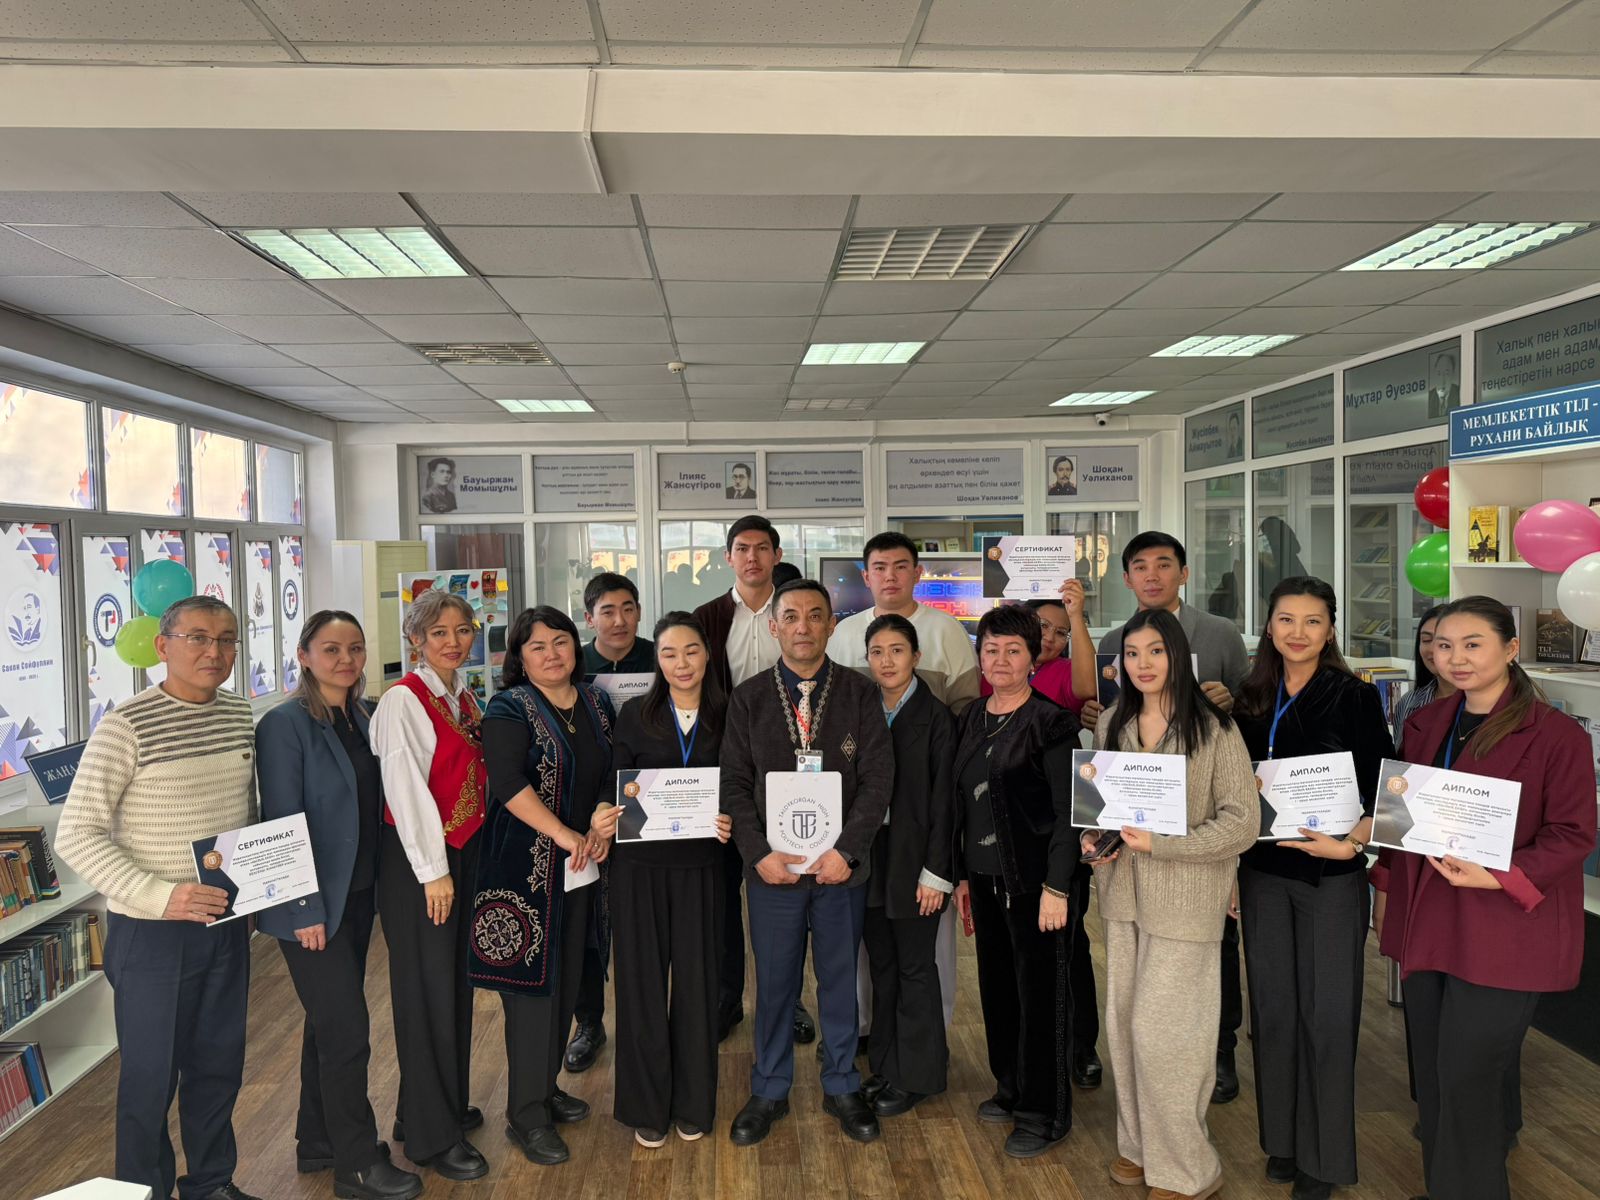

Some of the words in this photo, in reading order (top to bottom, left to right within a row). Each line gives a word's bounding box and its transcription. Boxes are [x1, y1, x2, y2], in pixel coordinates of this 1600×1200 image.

[1496, 336, 1534, 355] Халық
[1536, 330, 1559, 345] пен
[1563, 318, 1600, 338] халы
[1502, 355, 1532, 371] адам
[1536, 347, 1559, 362] мен
[1482, 366, 1552, 391] теңестіретін
[1385, 379, 1426, 400] Әуезов
[1463, 402, 1560, 431] МЕМЛЕКЕТТІК
[1563, 397, 1590, 415] ТІЛ
[1470, 429, 1521, 447] РУХАНИ
[1525, 418, 1589, 440] БАЙЛЫҚ
[908, 457, 946, 465] Халықтың
[1092, 465, 1124, 474] Шоқан
[463, 475, 514, 485] Бауыржан
[679, 472, 706, 480] Ілияс
[1082, 473, 1133, 482] Уәлиханов
[460, 484, 518, 493] Момышұлы
[663, 480, 722, 491] Жансүгіров
[618, 681, 649, 689] ДИПЛОМ
[1123, 764, 1162, 773] ДИПЛОМ
[1289, 766, 1330, 778] ДИПЛОМ
[664, 778, 700, 786] ДИПЛОМ
[1441, 783, 1490, 798] ДИПЛОМ
[237, 829, 295, 851] СЕРТИФИКАТ
